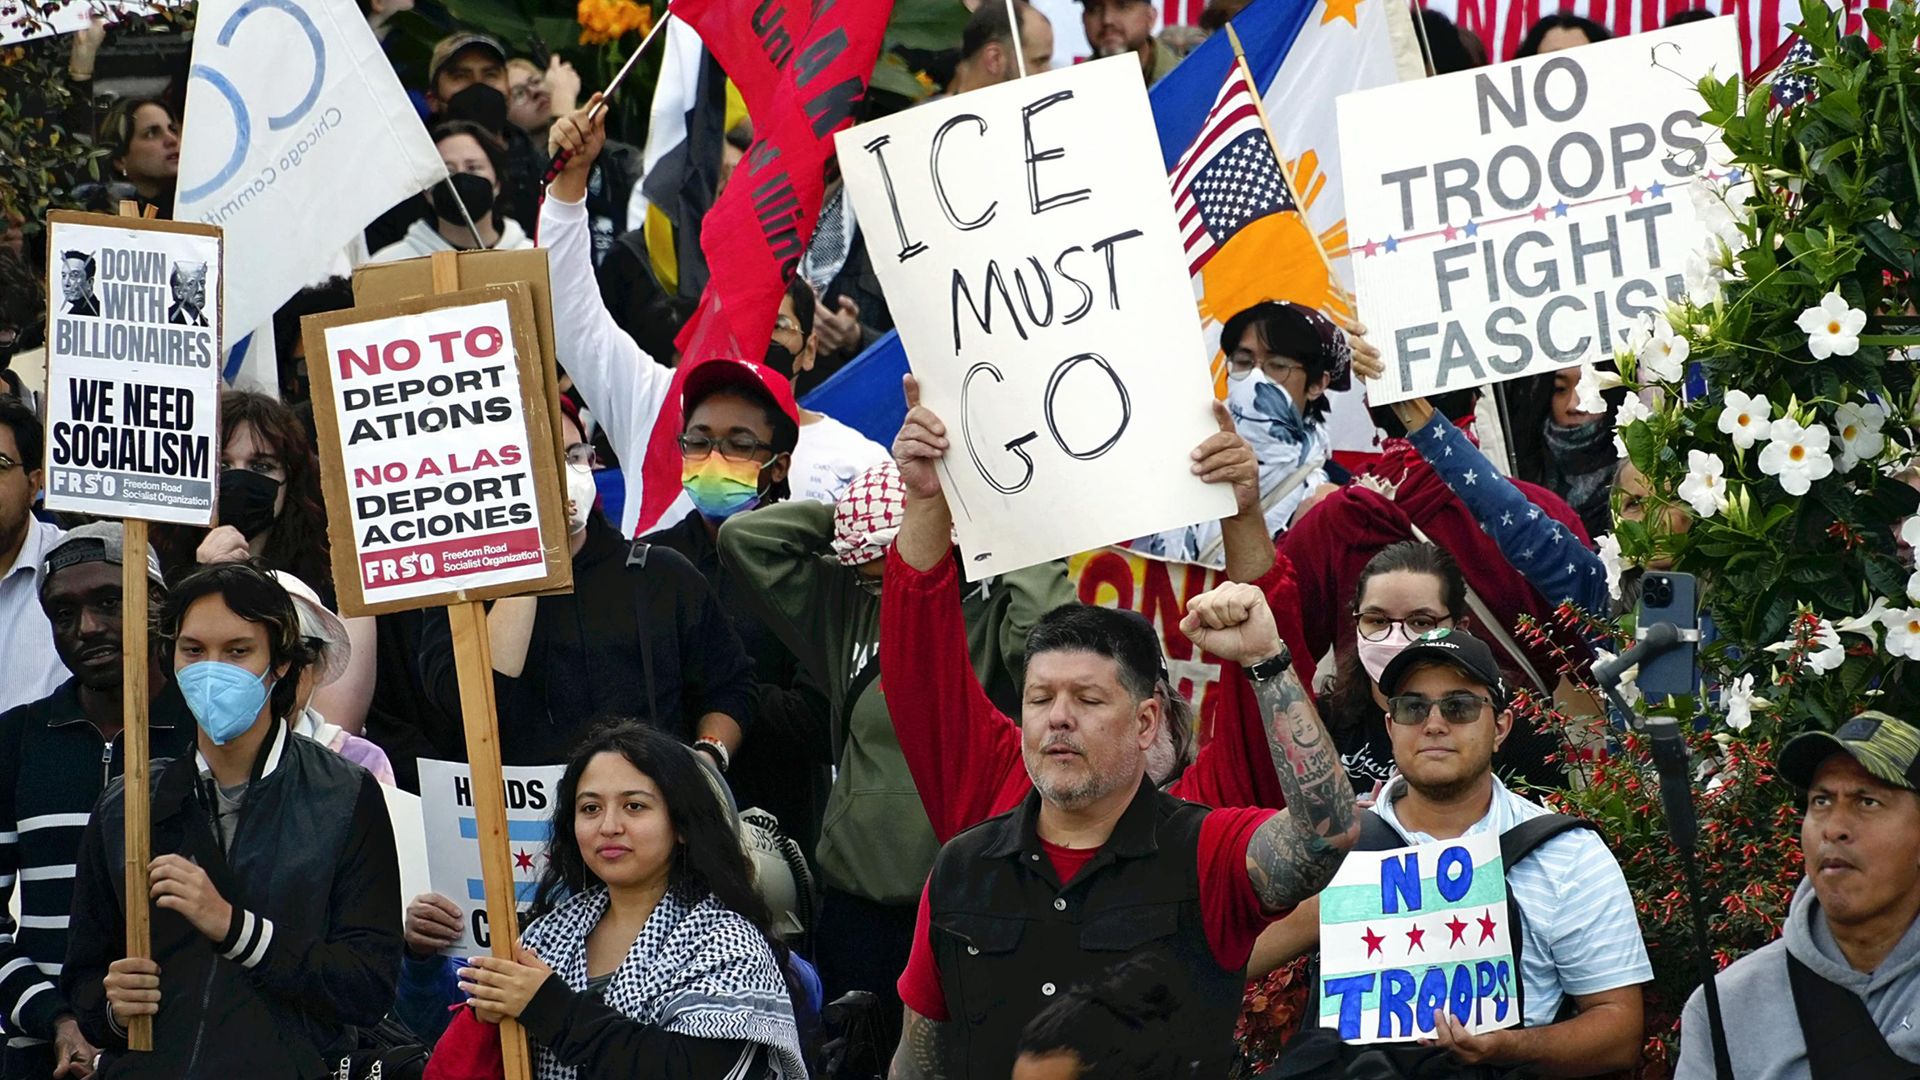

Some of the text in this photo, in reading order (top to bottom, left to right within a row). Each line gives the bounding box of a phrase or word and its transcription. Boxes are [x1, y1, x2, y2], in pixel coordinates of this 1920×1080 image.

[1475, 56, 1588, 136] NO
[864, 90, 1092, 263] ICE
[1381, 109, 1708, 231] TROOPS
[101, 248, 167, 285] DOWN
[1433, 202, 1673, 313] FIGHT
[102, 282, 166, 324] WITH
[952, 229, 1144, 356] MUST
[56, 319, 211, 369] BILLIONAIRES
[337, 326, 503, 380] NO TO
[69, 377, 194, 431] WE NEED
[343, 365, 505, 411] DEPORT
[348, 397, 512, 445] ATIONS
[960, 352, 1131, 494] GO
[53, 421, 209, 479] SOCIALISM
[354, 444, 522, 488] NO A LAS
[123, 479, 182, 493] Freedom Road
[123, 489, 209, 506] Socialist Organization
[356, 472, 526, 520] DEPORT
[361, 502, 532, 548] ACIONES
[442, 542, 508, 561] Freedom Road
[443, 551, 539, 573] Socialist Organization
[1381, 846, 1473, 914] NO
[1324, 960, 1510, 1040] TROOPS
